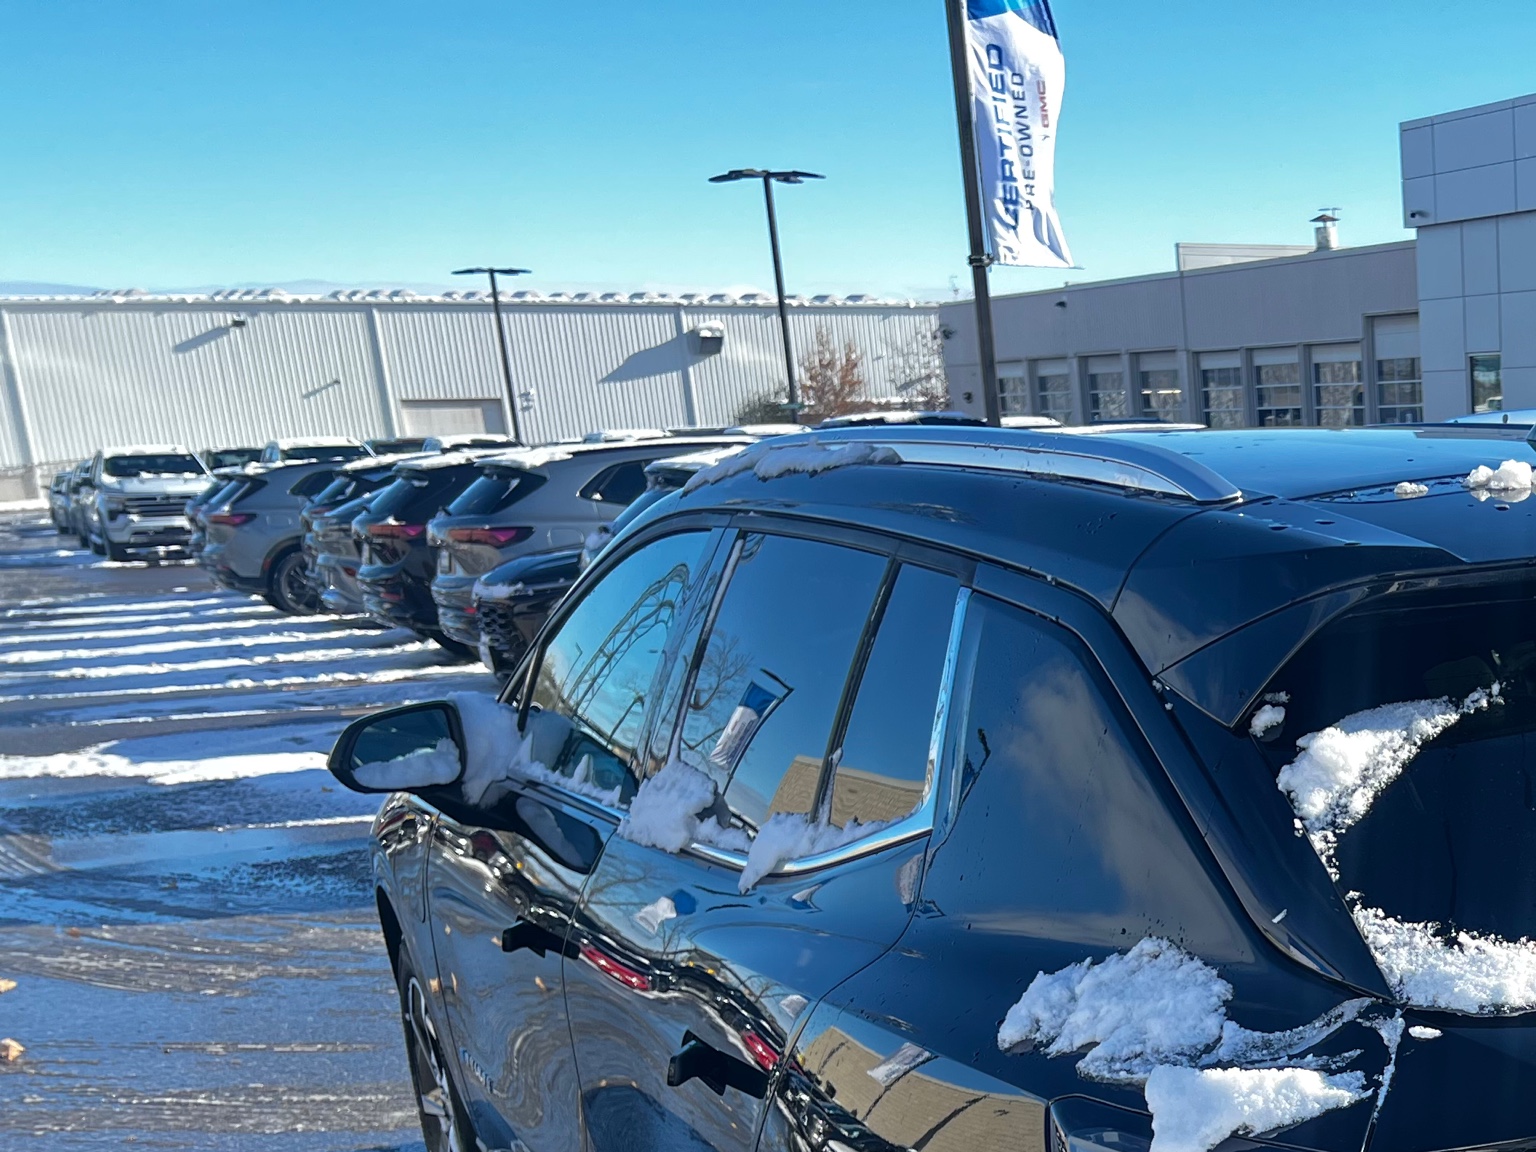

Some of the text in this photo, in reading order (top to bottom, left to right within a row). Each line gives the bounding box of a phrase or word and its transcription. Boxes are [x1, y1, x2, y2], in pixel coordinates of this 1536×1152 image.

[986, 43, 1020, 230] CERTIFIED
[1010, 71, 1036, 210] PRE-OWNED
[1036, 79, 1050, 128] GMC
